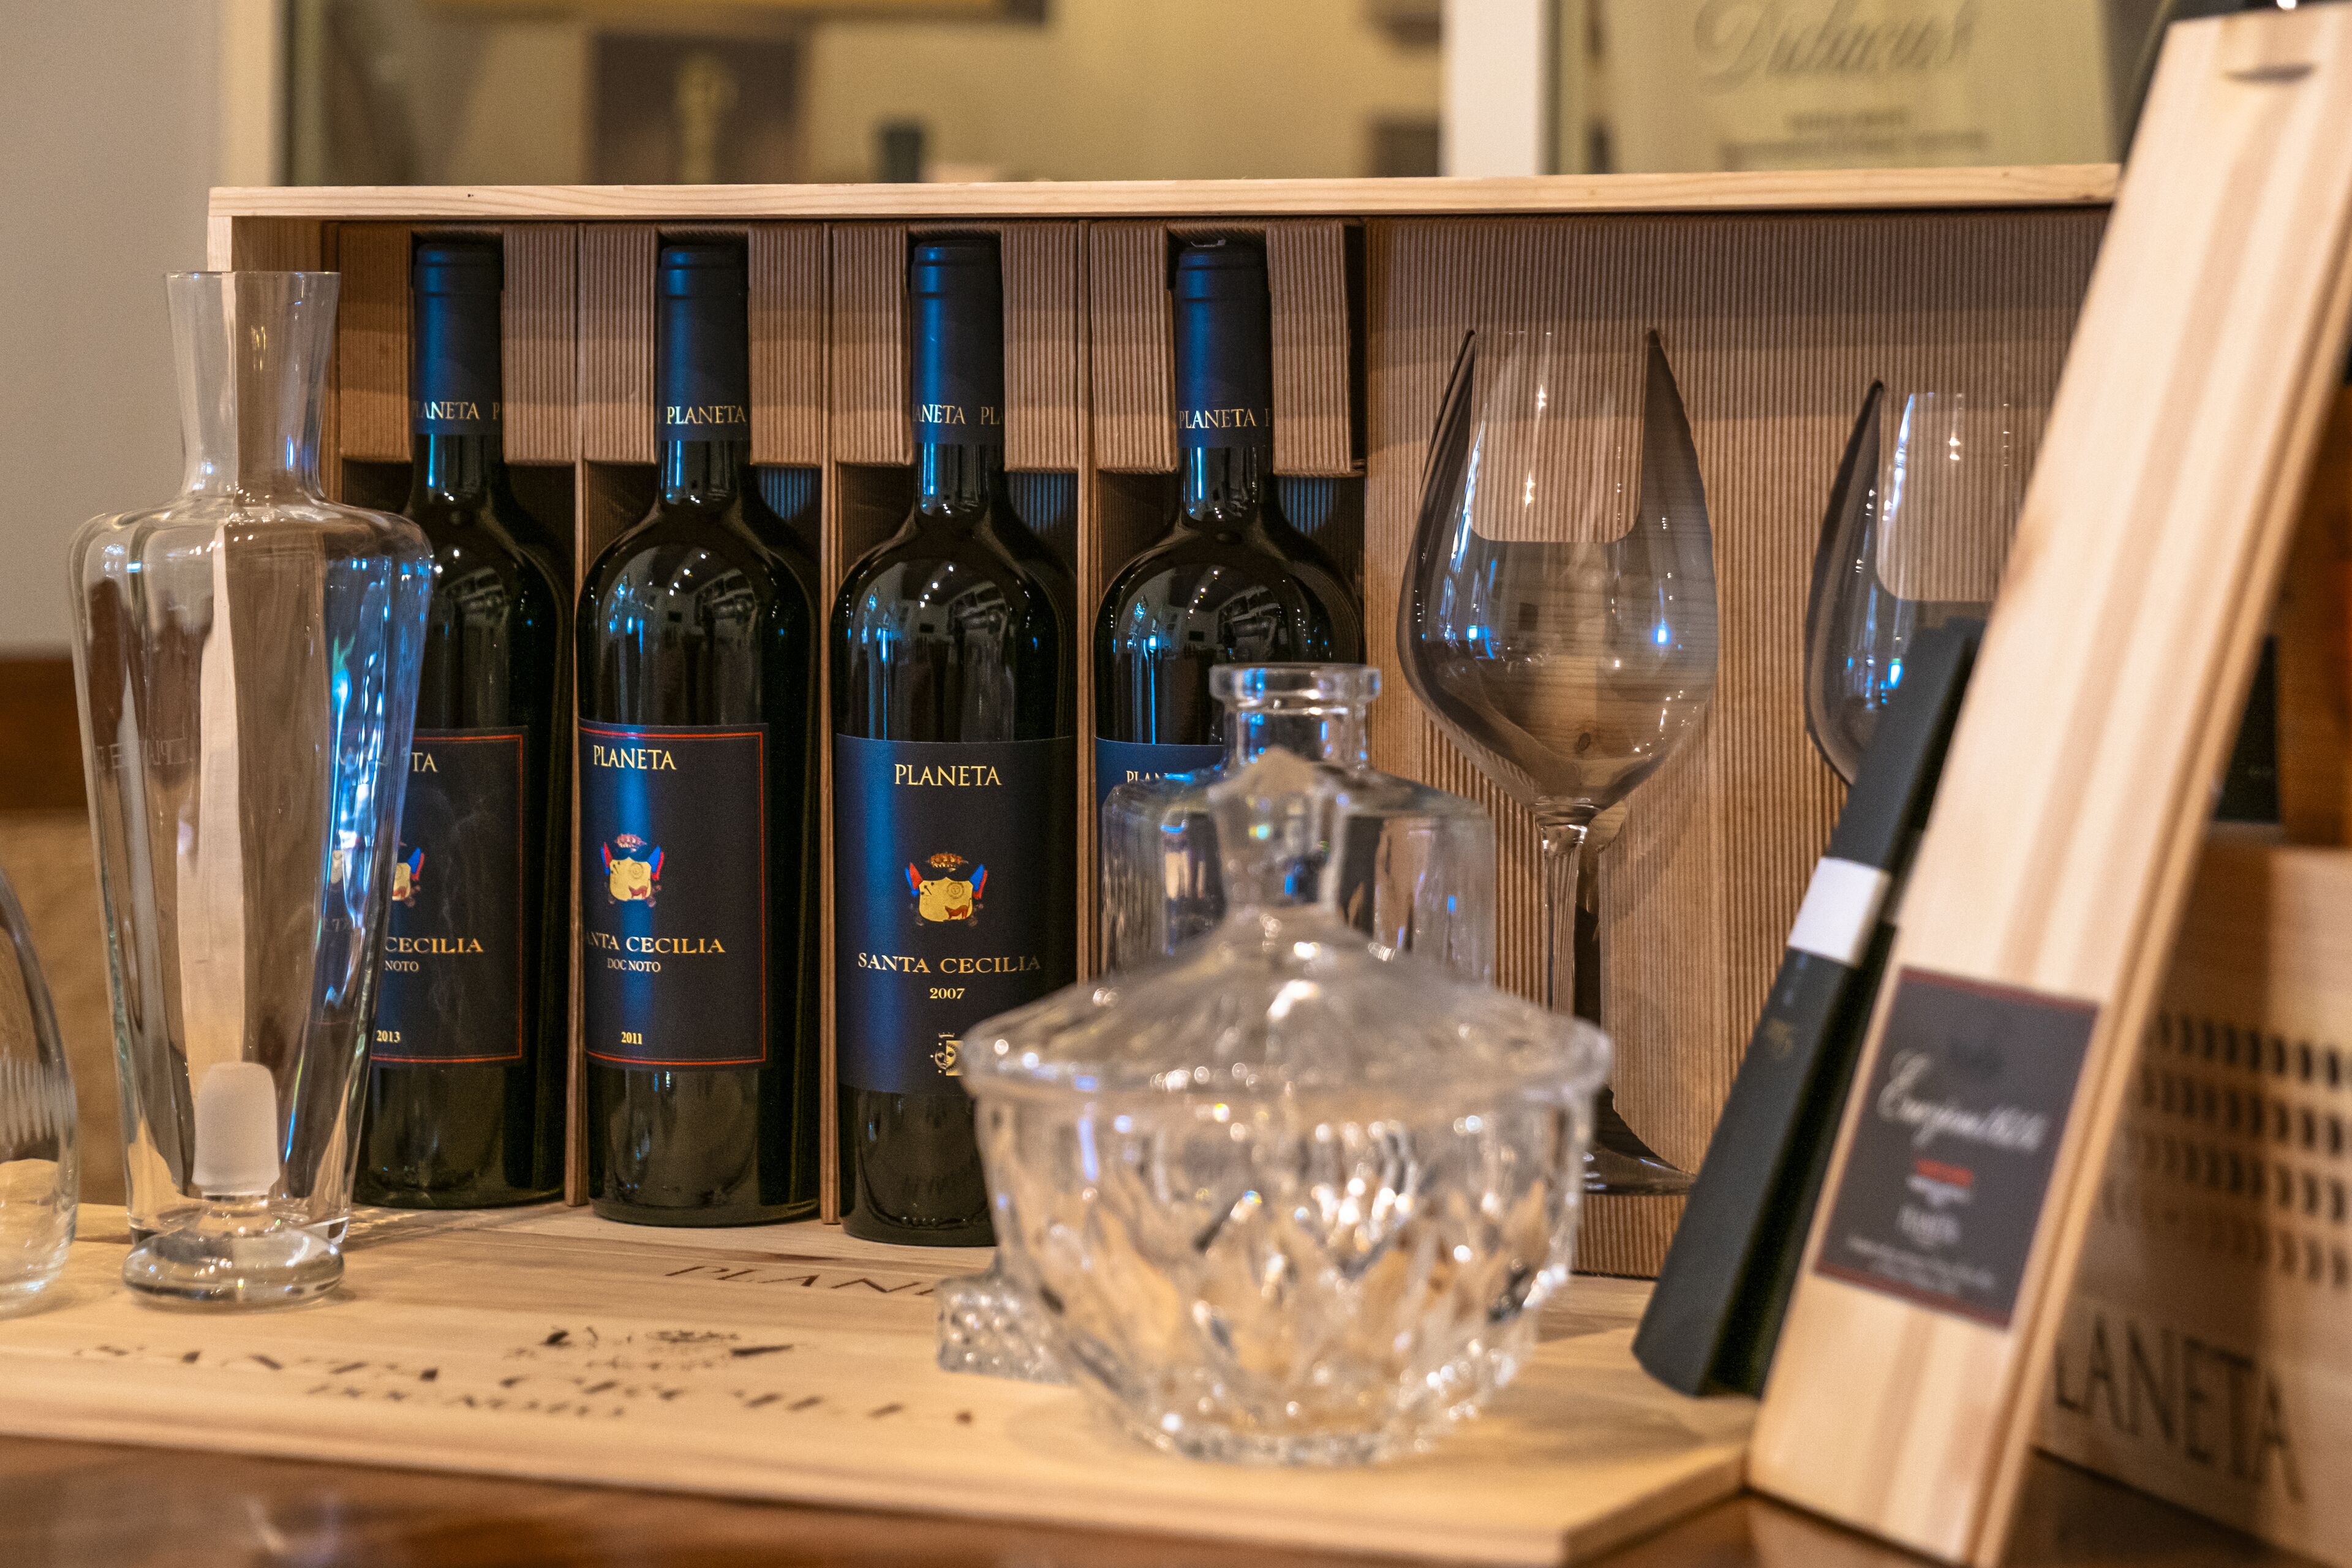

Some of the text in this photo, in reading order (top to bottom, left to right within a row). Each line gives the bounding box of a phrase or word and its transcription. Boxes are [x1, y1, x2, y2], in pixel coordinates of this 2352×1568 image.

[666, 405, 746, 424] PLANETA
[1179, 408, 1257, 428] PLANETA
[593, 745, 676, 770] PLANETA
[894, 764, 1002, 786] PLANETA
[385, 937, 484, 954] CECILIA
[626, 936, 726, 954] CECILIA
[385, 960, 420, 973] NOTO
[607, 957, 662, 973] DOC NOTO
[858, 952, 1041, 974] SANTA CECILIA
[929, 987, 965, 1000] 2007
[376, 1030, 401, 1043] 2013
[621, 1031, 643, 1045] 2011
[665, 1264, 935, 1296] PLAN
[2053, 1310, 2306, 1504] LANETA
